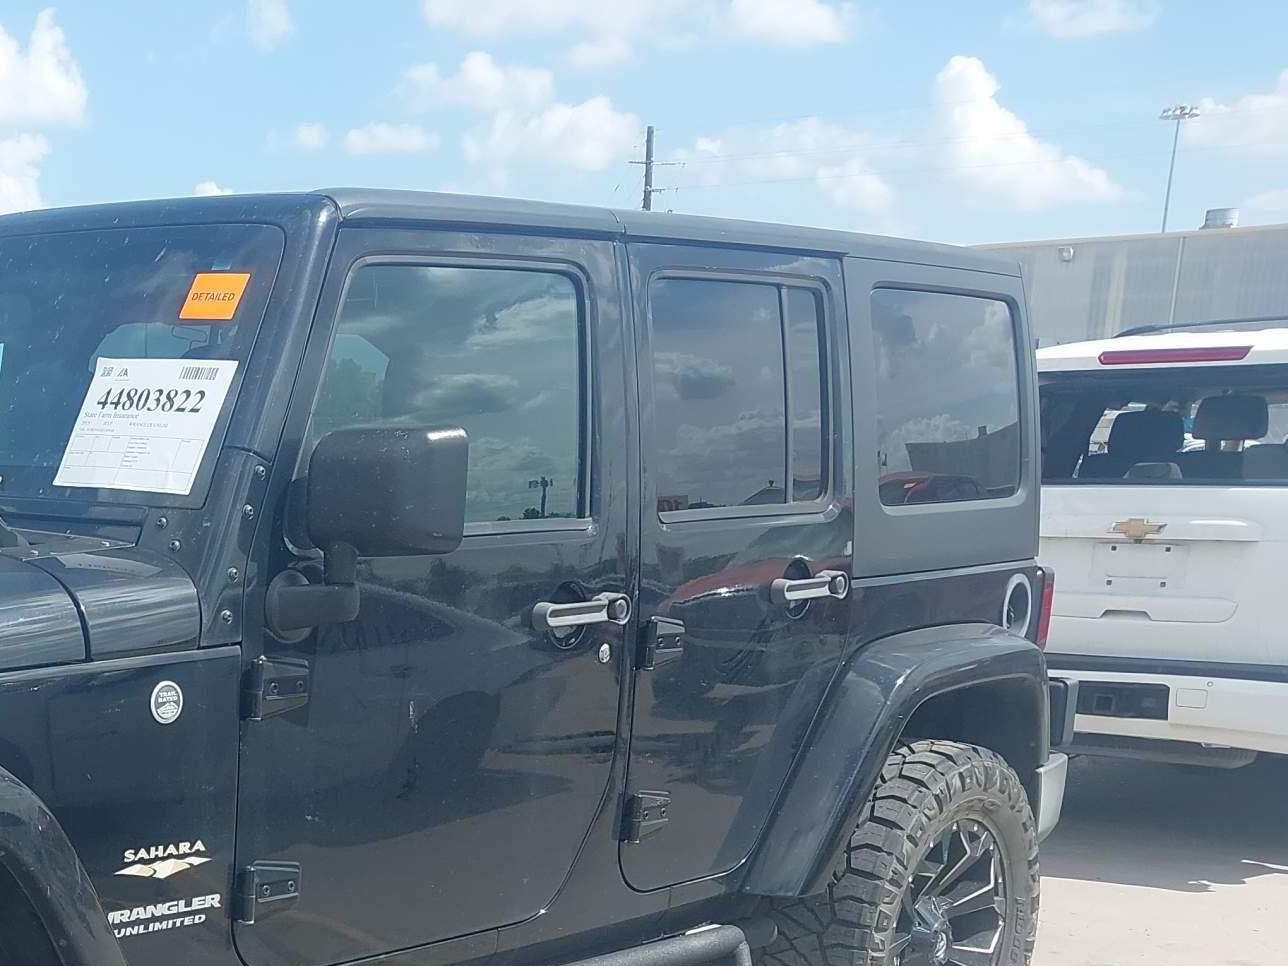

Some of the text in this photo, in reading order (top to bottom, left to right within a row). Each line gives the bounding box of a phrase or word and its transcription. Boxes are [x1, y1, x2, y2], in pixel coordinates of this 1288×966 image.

[192, 292, 235, 301] DETAILED
[97, 387, 206, 413] 44803822
[124, 839, 206, 862] SAHARA
[113, 914, 206, 938] UNLIMITED
